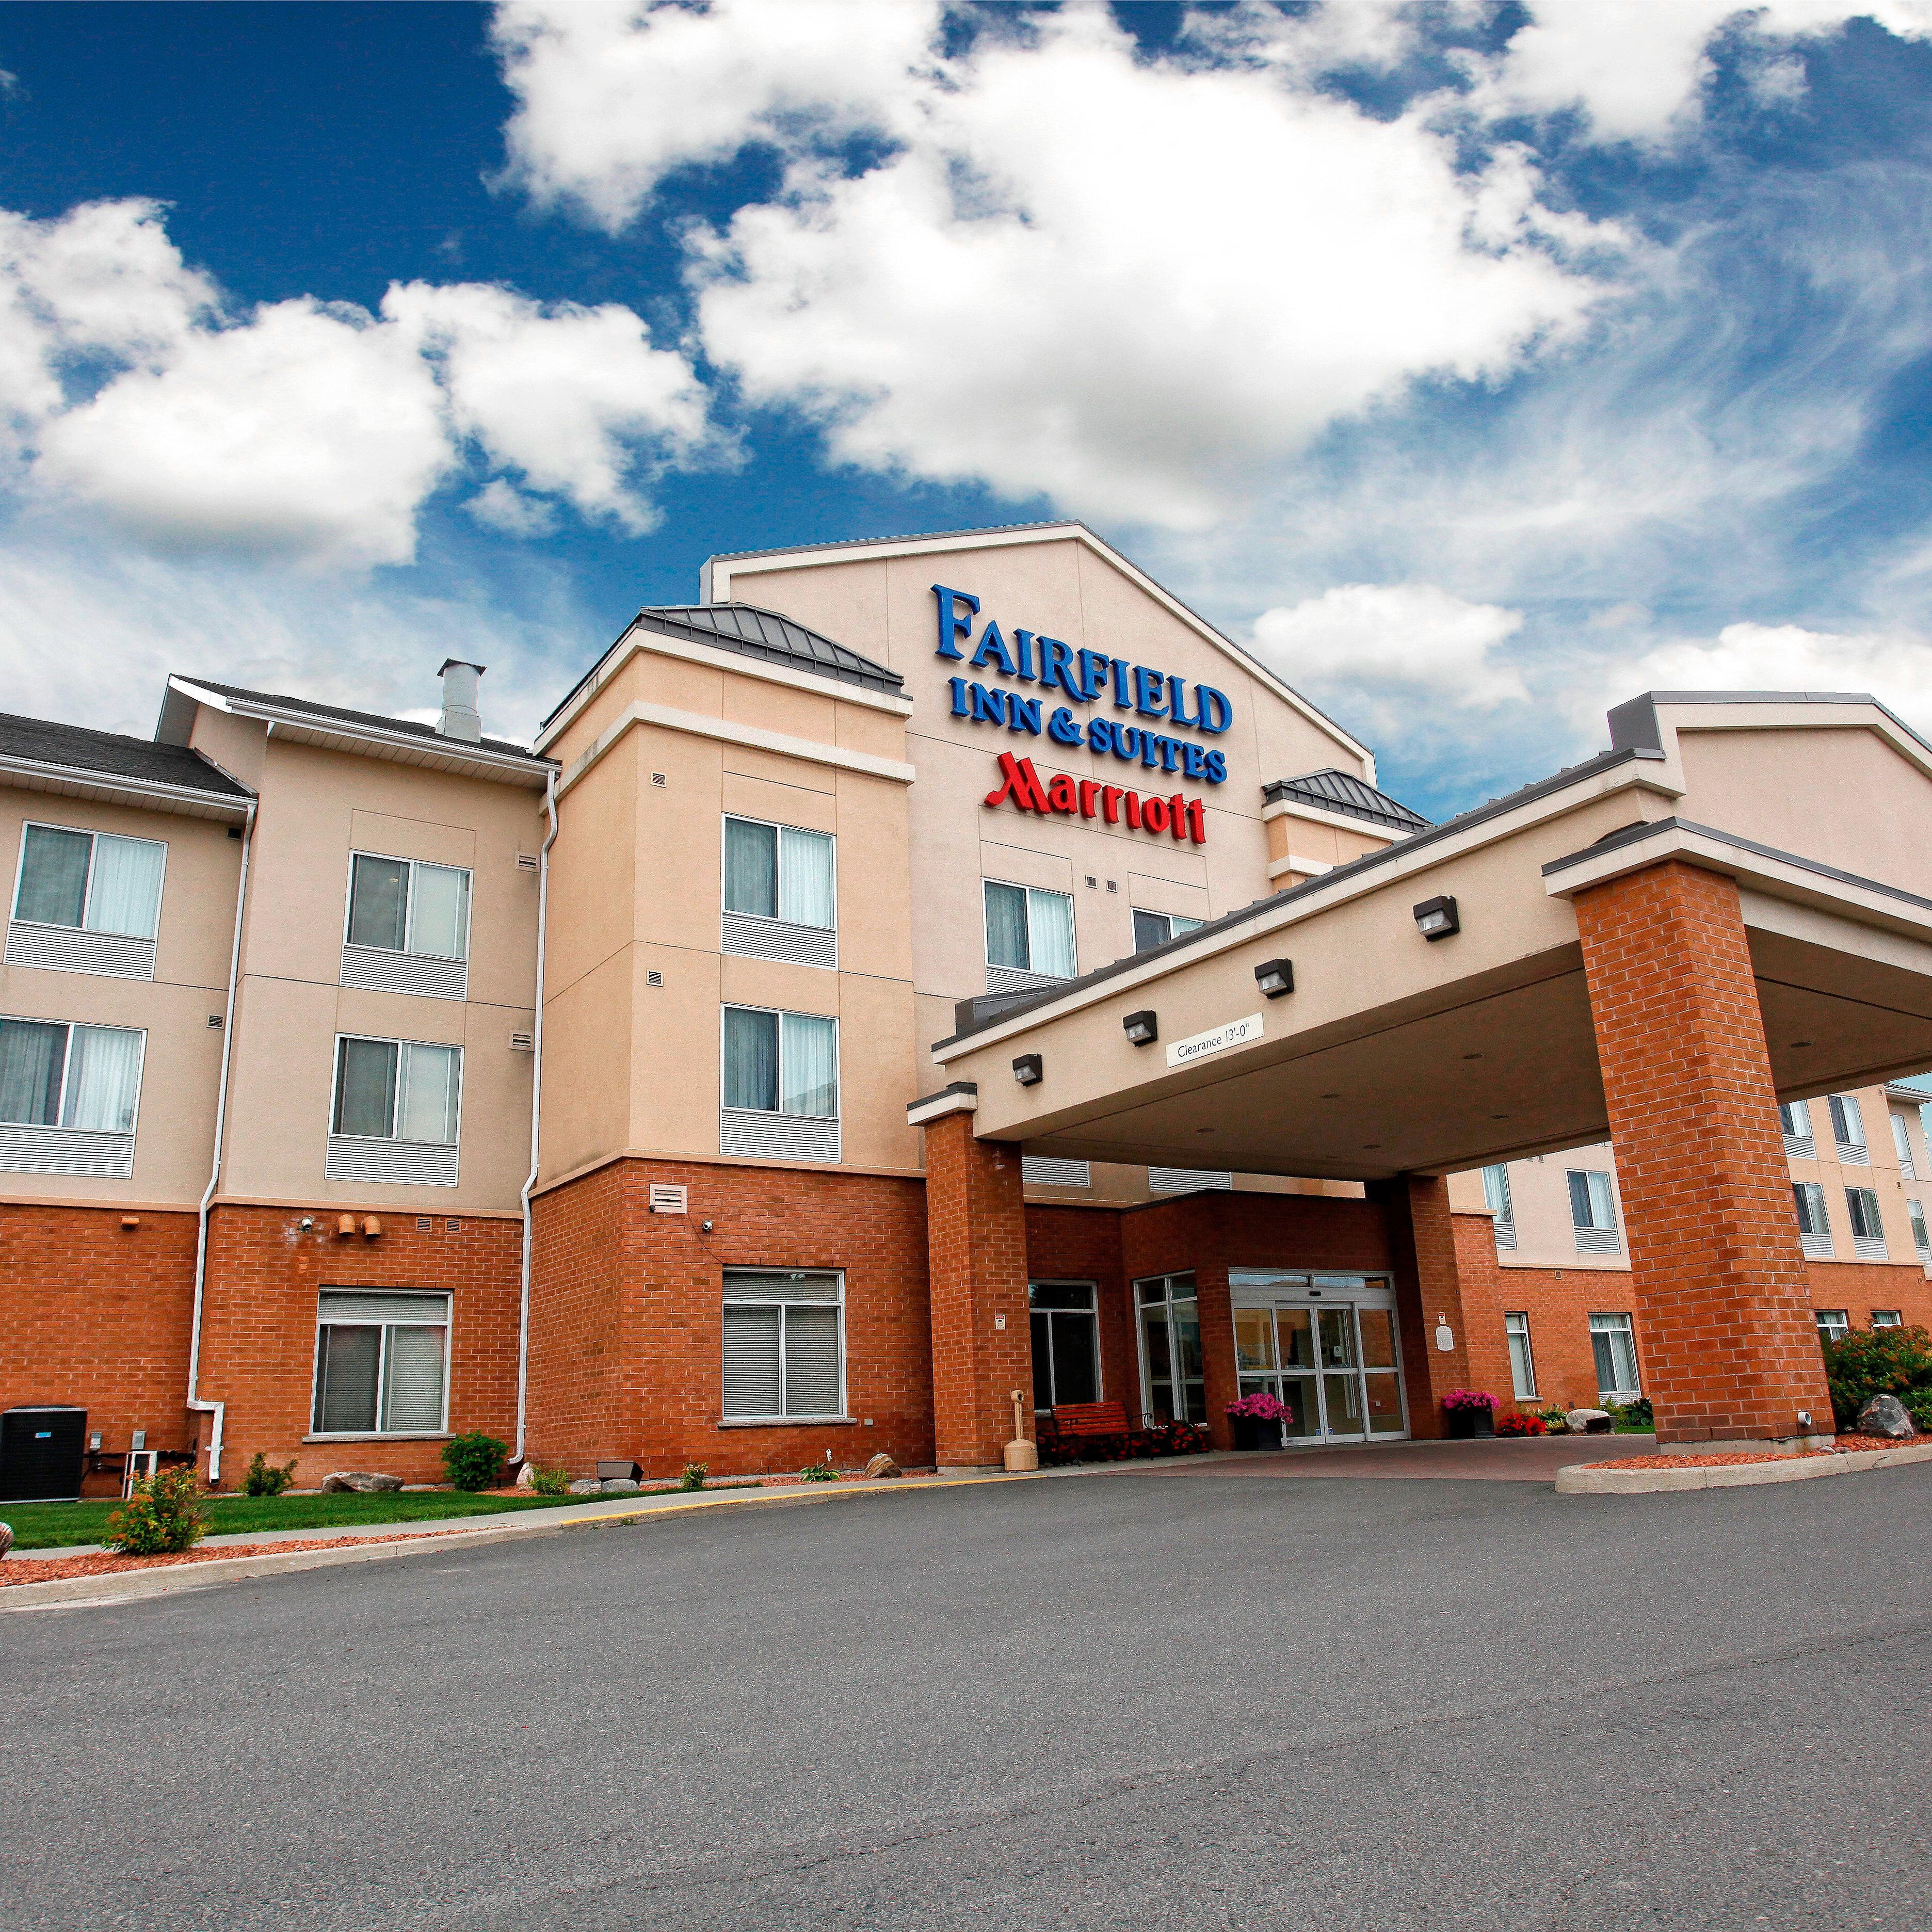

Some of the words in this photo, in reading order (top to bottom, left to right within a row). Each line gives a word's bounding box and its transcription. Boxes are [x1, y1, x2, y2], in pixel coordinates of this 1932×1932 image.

[930, 584, 1233, 734] FAIRFIELD
[948, 676, 1043, 736] INN
[1048, 706, 1086, 747] &
[1088, 717, 1228, 784] SUITES
[984, 751, 1206, 844] Marriott
[1178, 1036, 1222, 1057] Clearance
